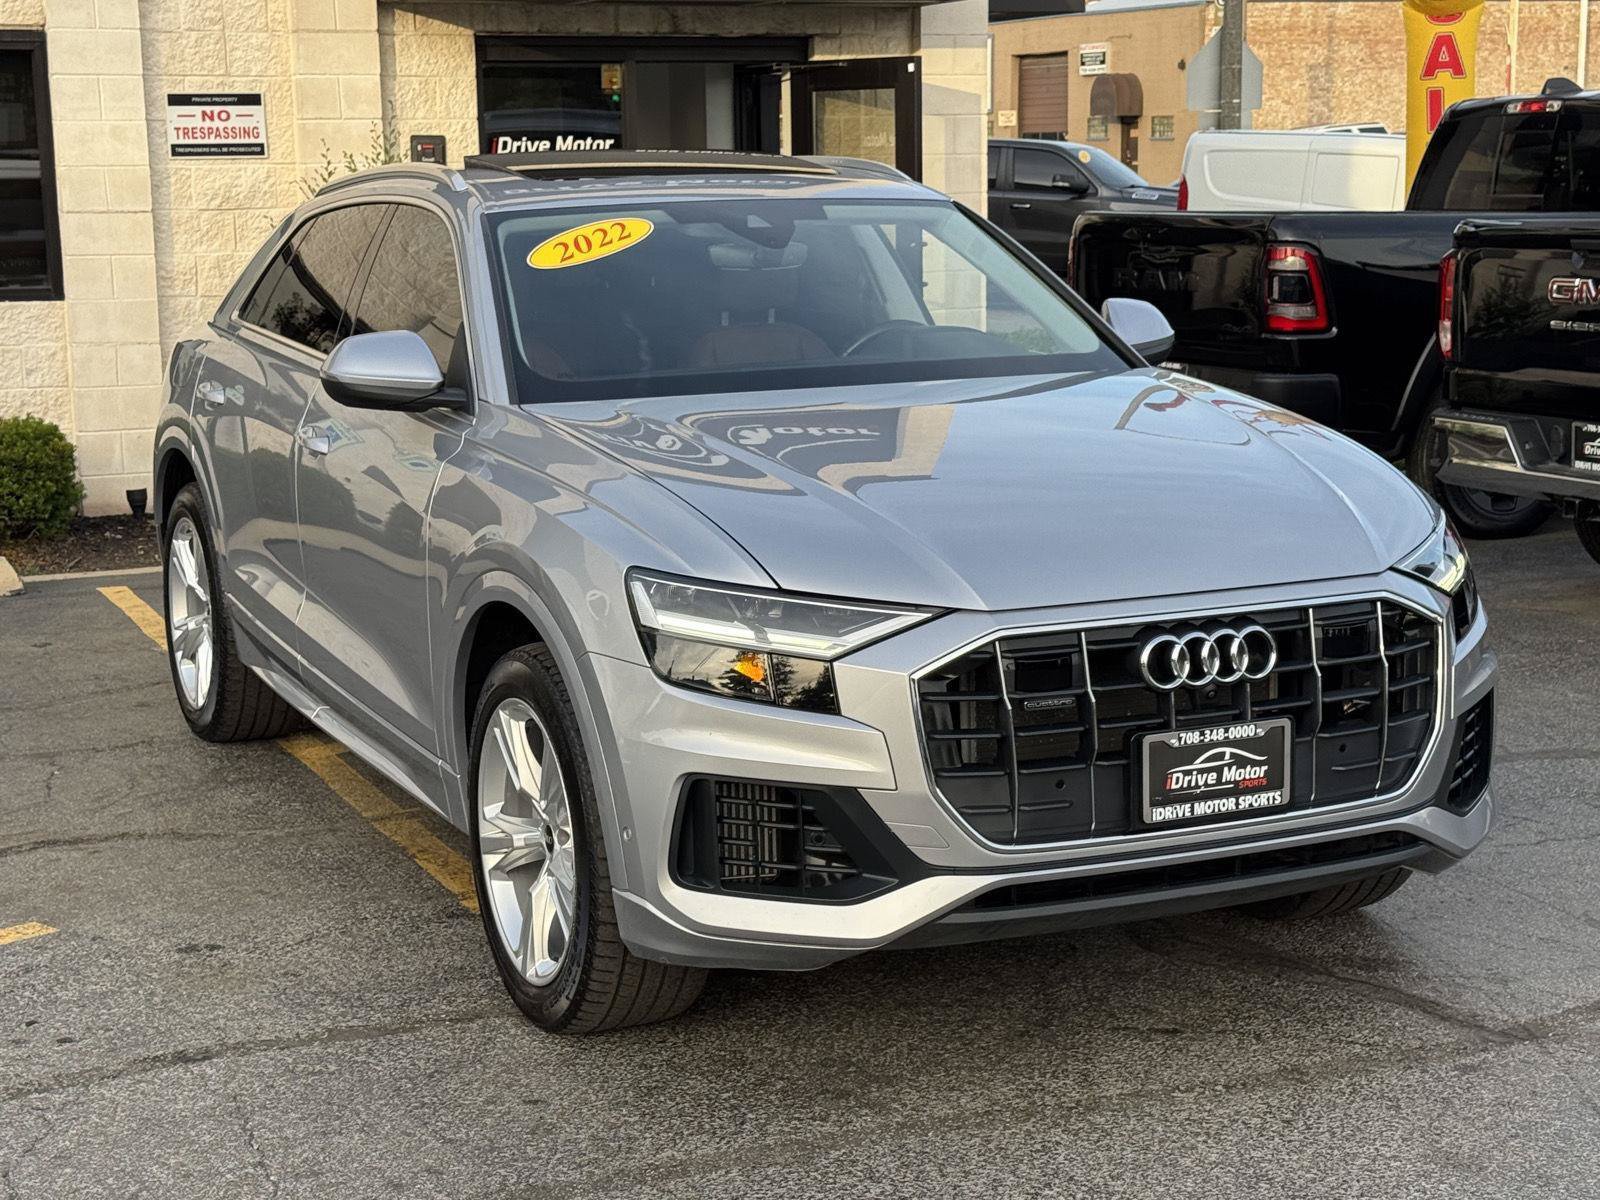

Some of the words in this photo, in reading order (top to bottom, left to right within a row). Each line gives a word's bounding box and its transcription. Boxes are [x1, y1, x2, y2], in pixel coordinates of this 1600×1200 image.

[201, 110, 231, 122] NO
[174, 127, 260, 140] TRESPASSING
[555, 135, 614, 151] Motor
[553, 222, 632, 263] 2022
[1179, 724, 1256, 745] 708-348-0000
[1166, 771, 1218, 790] iDrive
[1221, 765, 1268, 782] Motor
[1238, 777, 1268, 789] SPORTS
[1194, 798, 1237, 816] MOTOR
[1238, 791, 1282, 809] SPORTS
